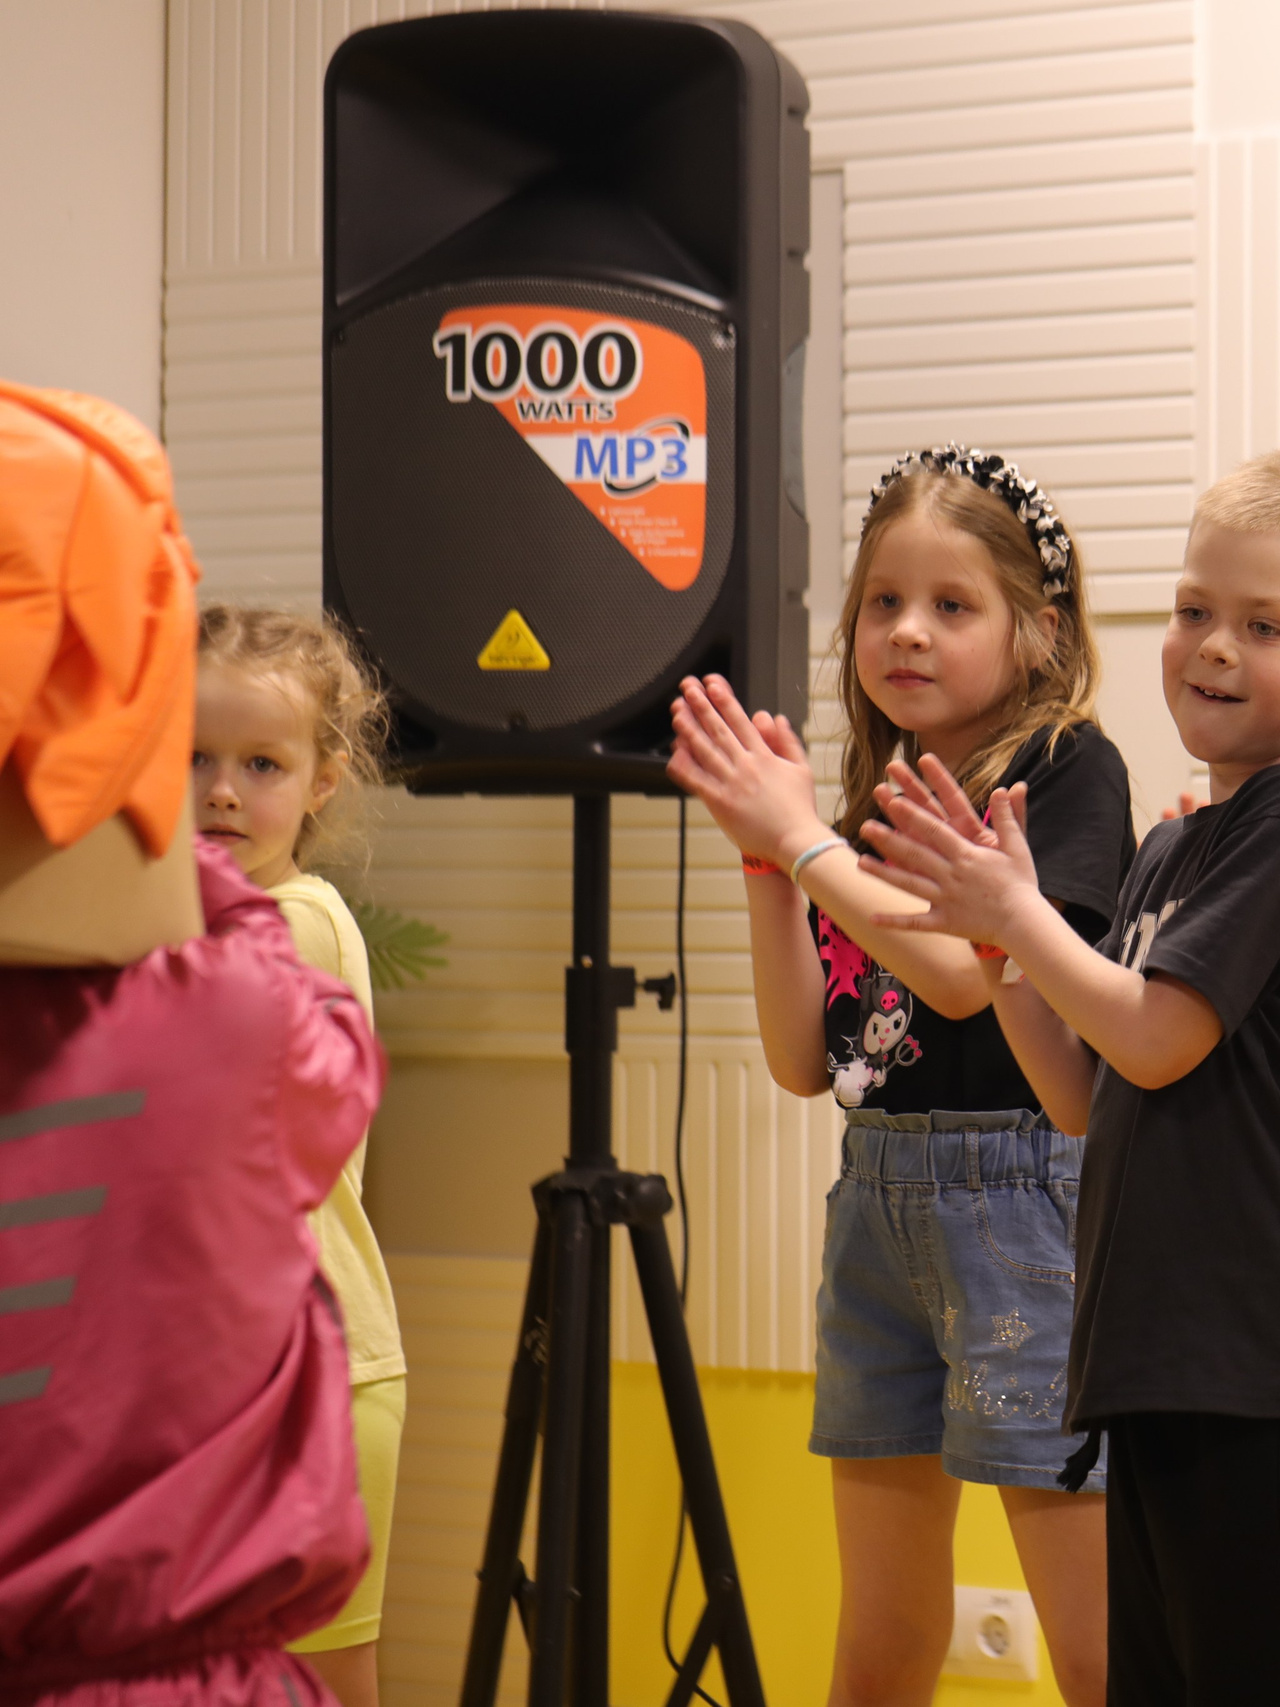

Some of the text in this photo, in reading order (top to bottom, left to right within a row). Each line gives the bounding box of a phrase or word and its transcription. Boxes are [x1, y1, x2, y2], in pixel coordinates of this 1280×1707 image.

[435, 326, 640, 400] 1000
[517, 399, 615, 422] WATTS
[574, 433, 688, 479] MP3
